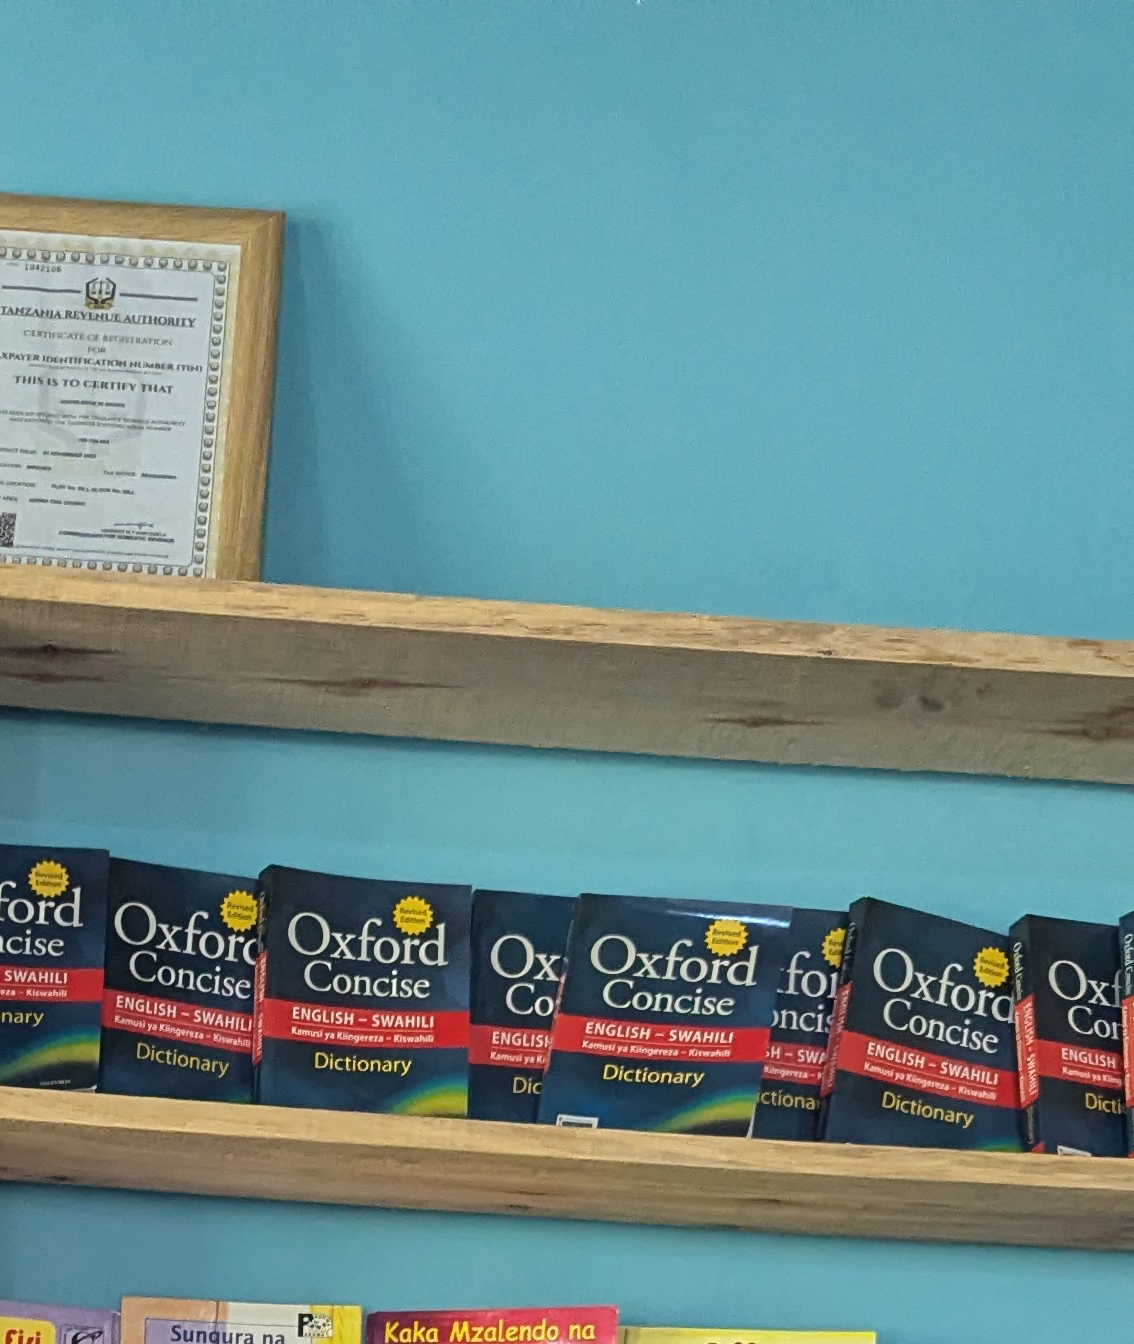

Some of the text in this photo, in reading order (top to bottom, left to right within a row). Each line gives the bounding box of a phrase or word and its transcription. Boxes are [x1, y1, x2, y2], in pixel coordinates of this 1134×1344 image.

[0, 306, 197, 328] TANZANIA REVENUE AUTHORITY
[23, 329, 173, 346] CERTIFICATE OF REGISTRATION
[42, 355, 127, 368] IDENTIFICATION
[130, 361, 173, 371] NUMBER
[177, 363, 203, 373] (TIN)
[14, 375, 173, 394] THIS IS TO CERTIFY THAT
[288, 912, 448, 967] Oxford
[590, 934, 760, 986] Oxford
[4, 970, 68, 984] SWAHILI
[304, 960, 430, 999] Concise
[26, 987, 67, 998] Kiswahili
[602, 980, 734, 1016] Concise
[292, 1007, 435, 1029] ENGLISH SWAHILI
[585, 1022, 734, 1044] ENGLISH SWAHILI
[314, 1052, 413, 1077] Dictionary
[602, 1064, 704, 1087] Dictionary
[384, 1318, 595, 1344] Kaka Mzalendo na
